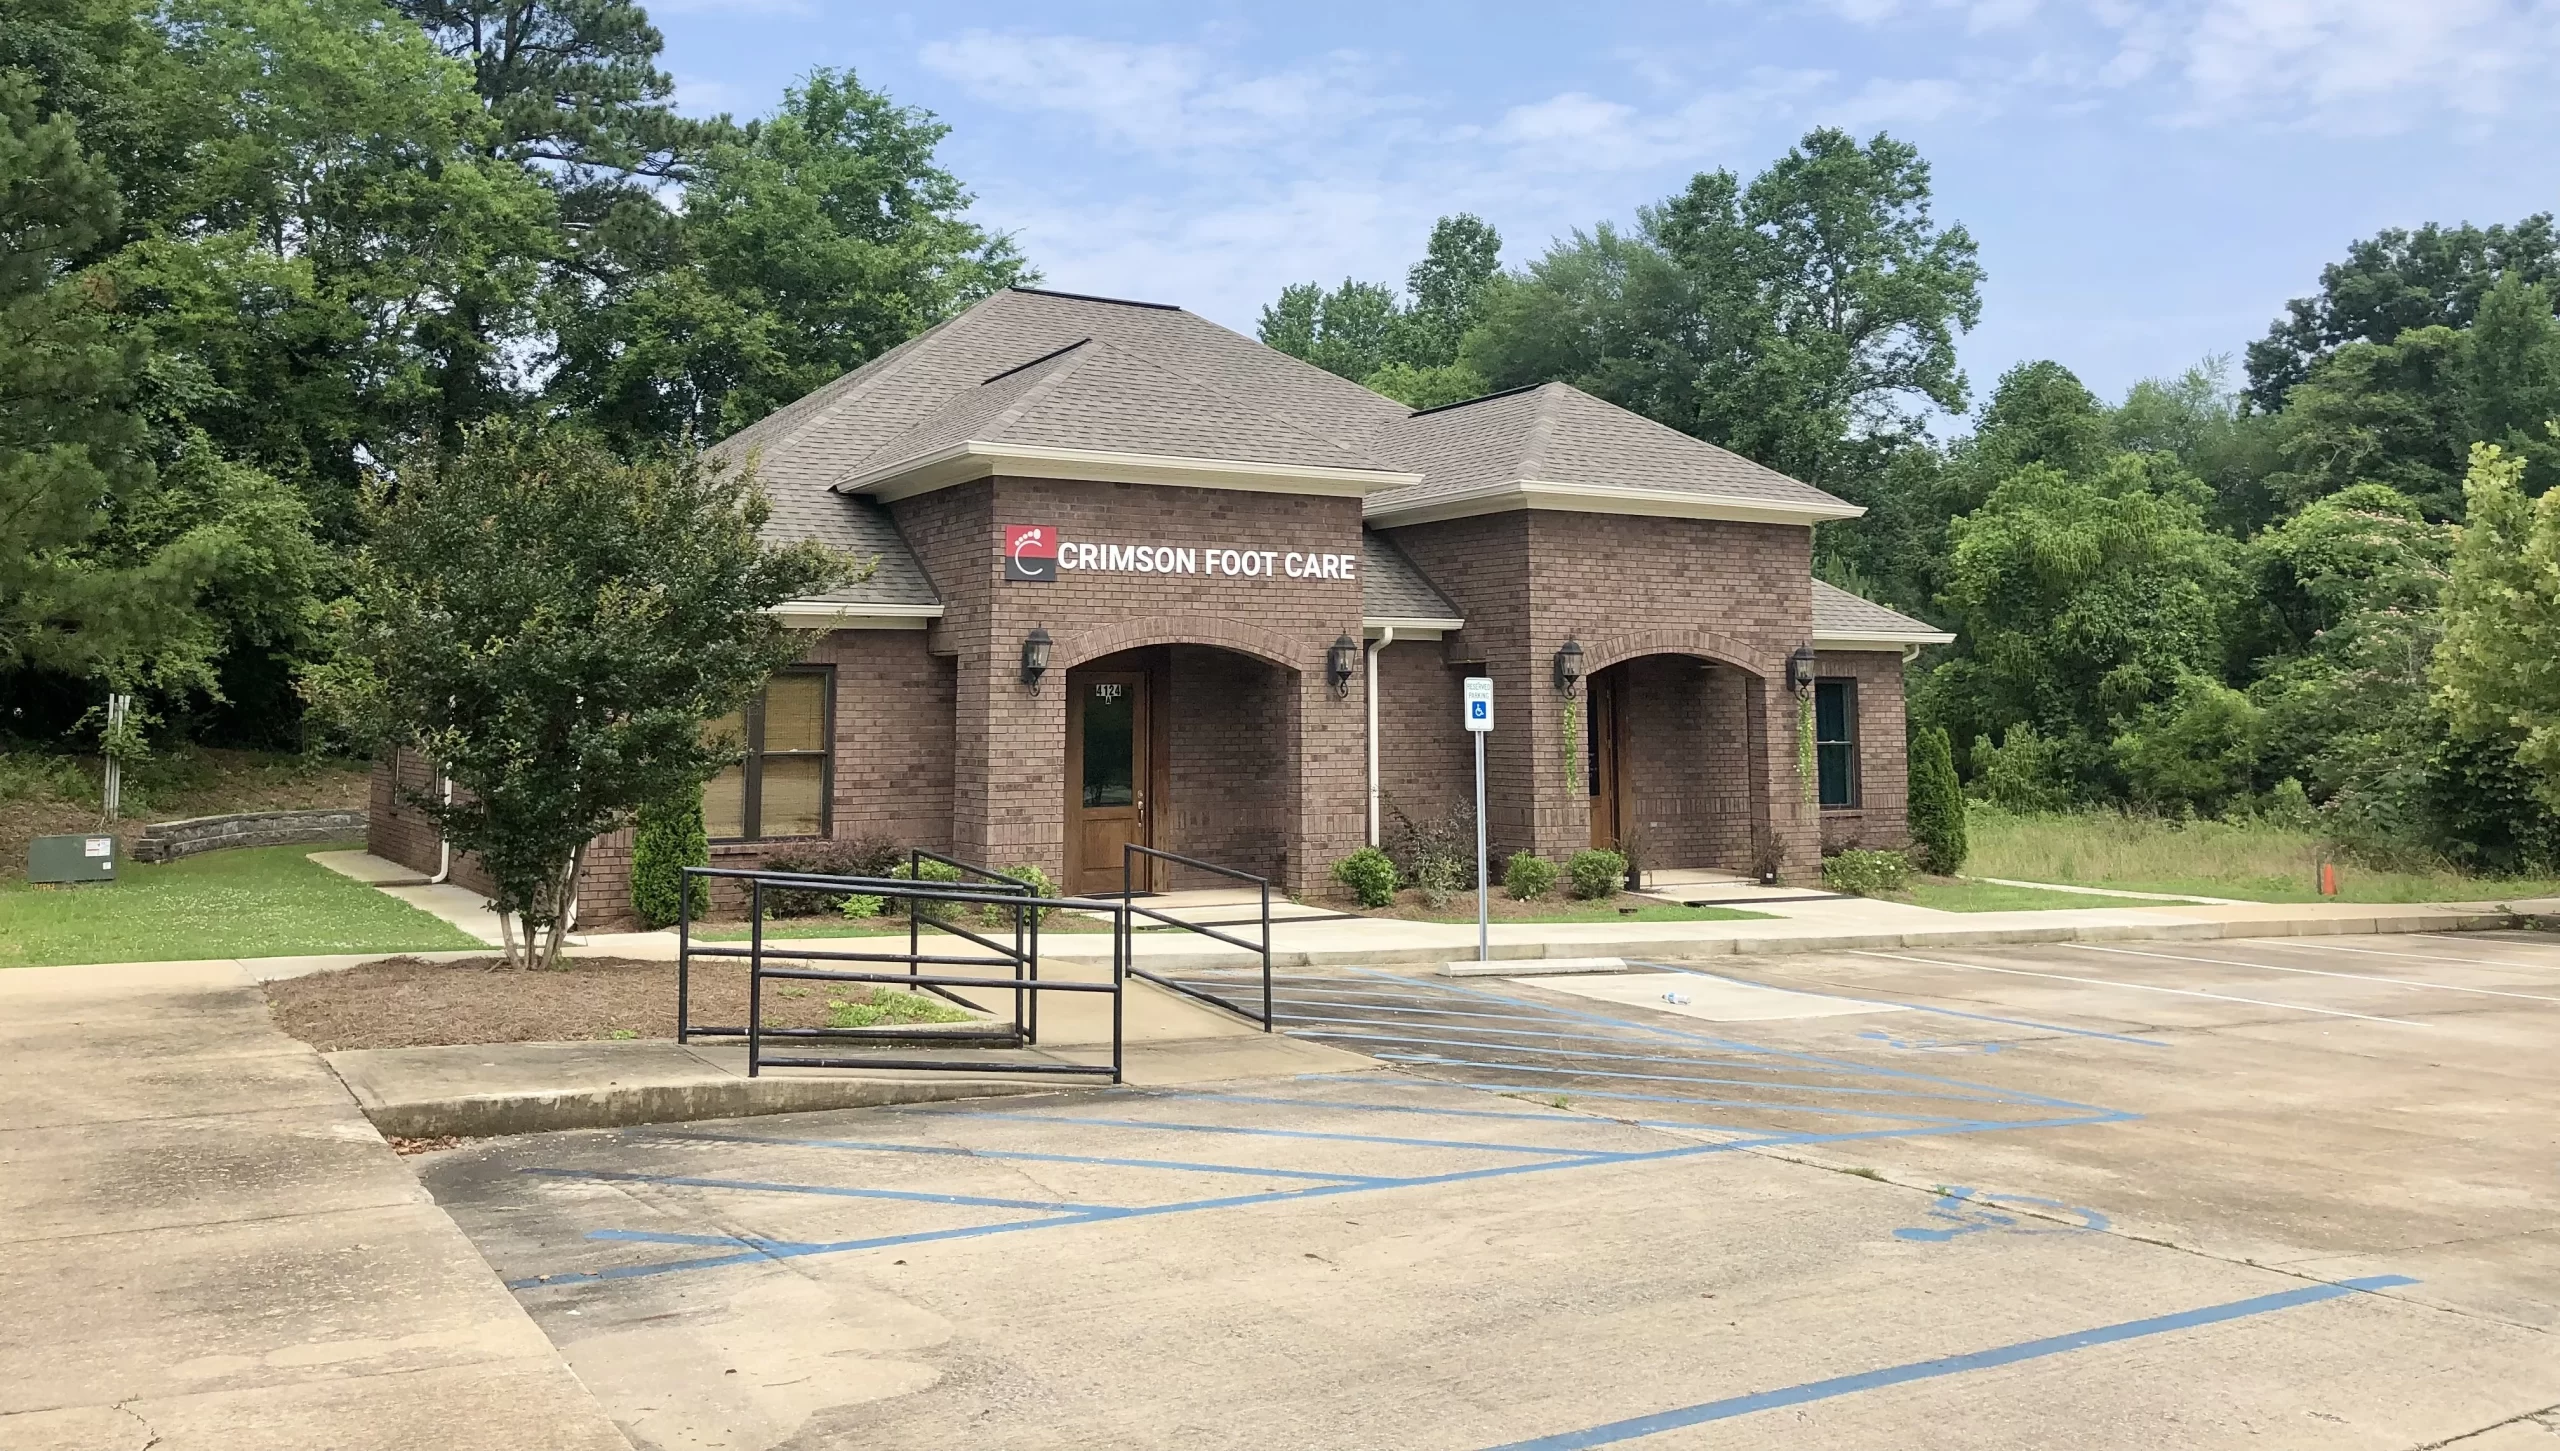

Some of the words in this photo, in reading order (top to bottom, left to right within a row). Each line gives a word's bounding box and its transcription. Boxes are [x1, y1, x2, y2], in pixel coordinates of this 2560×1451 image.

[1057, 542, 1195, 575] CRIMSON
[1205, 548, 1278, 577] FOOT
[1285, 552, 1356, 580] CARE
[1096, 685, 1121, 696] 4124
[1466, 683, 1490, 691] RESERVED
